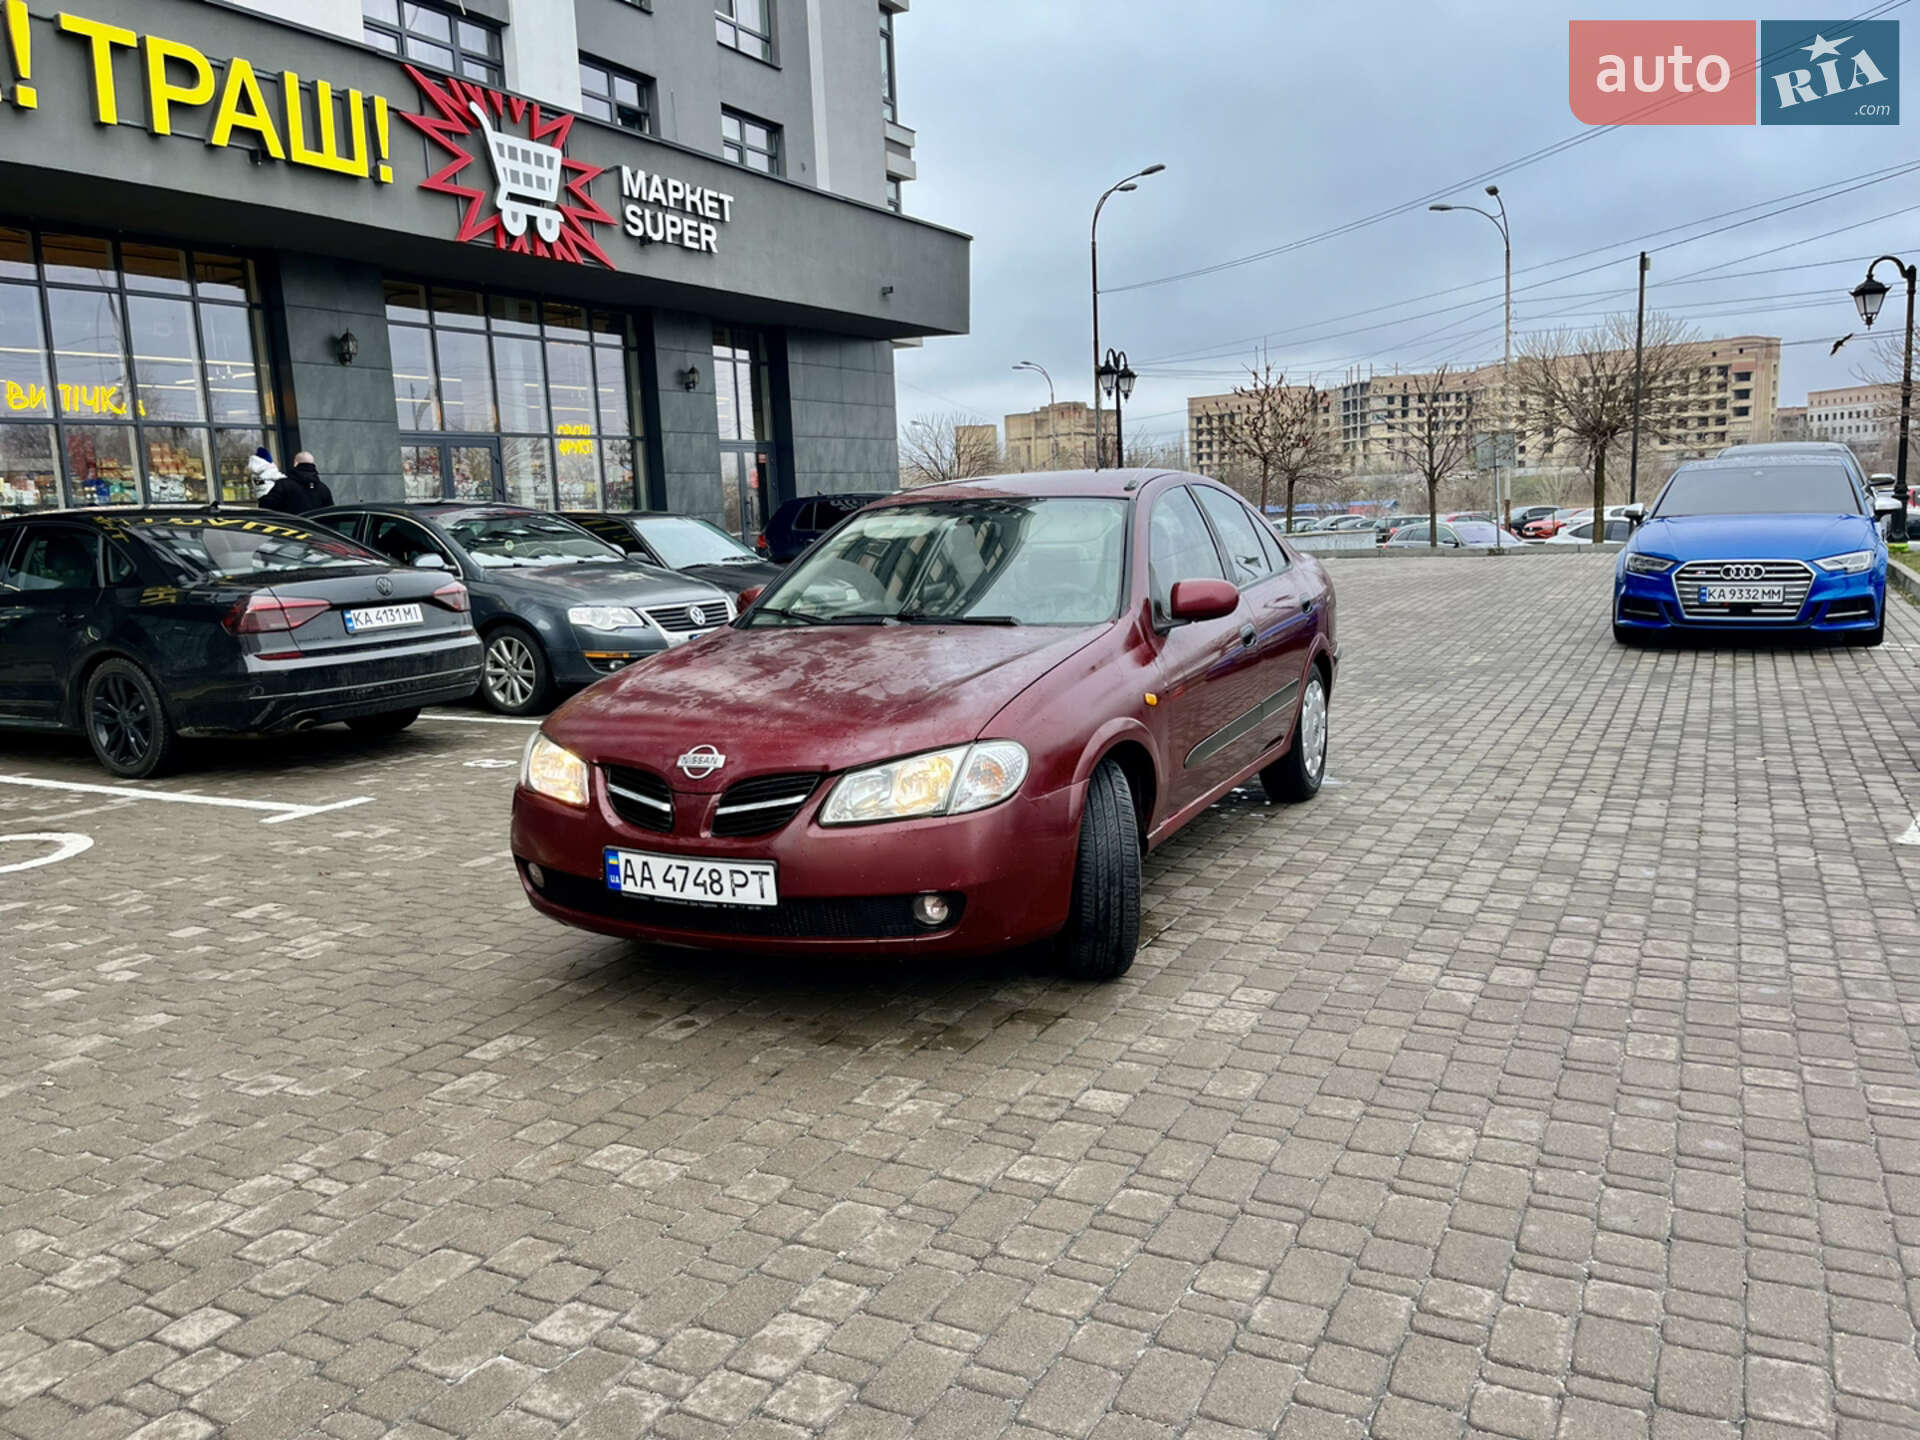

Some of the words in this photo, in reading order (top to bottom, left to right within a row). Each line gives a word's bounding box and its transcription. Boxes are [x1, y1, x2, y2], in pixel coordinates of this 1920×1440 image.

[622, 164, 734, 222] МАРКЕТ
[624, 203, 718, 254] SUPER
[1707, 588, 1726, 600] KA
[1728, 588, 1760, 600] 9332
[1761, 588, 1781, 600] MM
[352, 611, 373, 627] KA
[375, 607, 403, 624] 4131
[403, 605, 420, 621] MI
[681, 756, 718, 765] NISSAN
[623, 858, 656, 890] AA
[662, 863, 724, 896] 4748
[728, 869, 771, 899] PT
